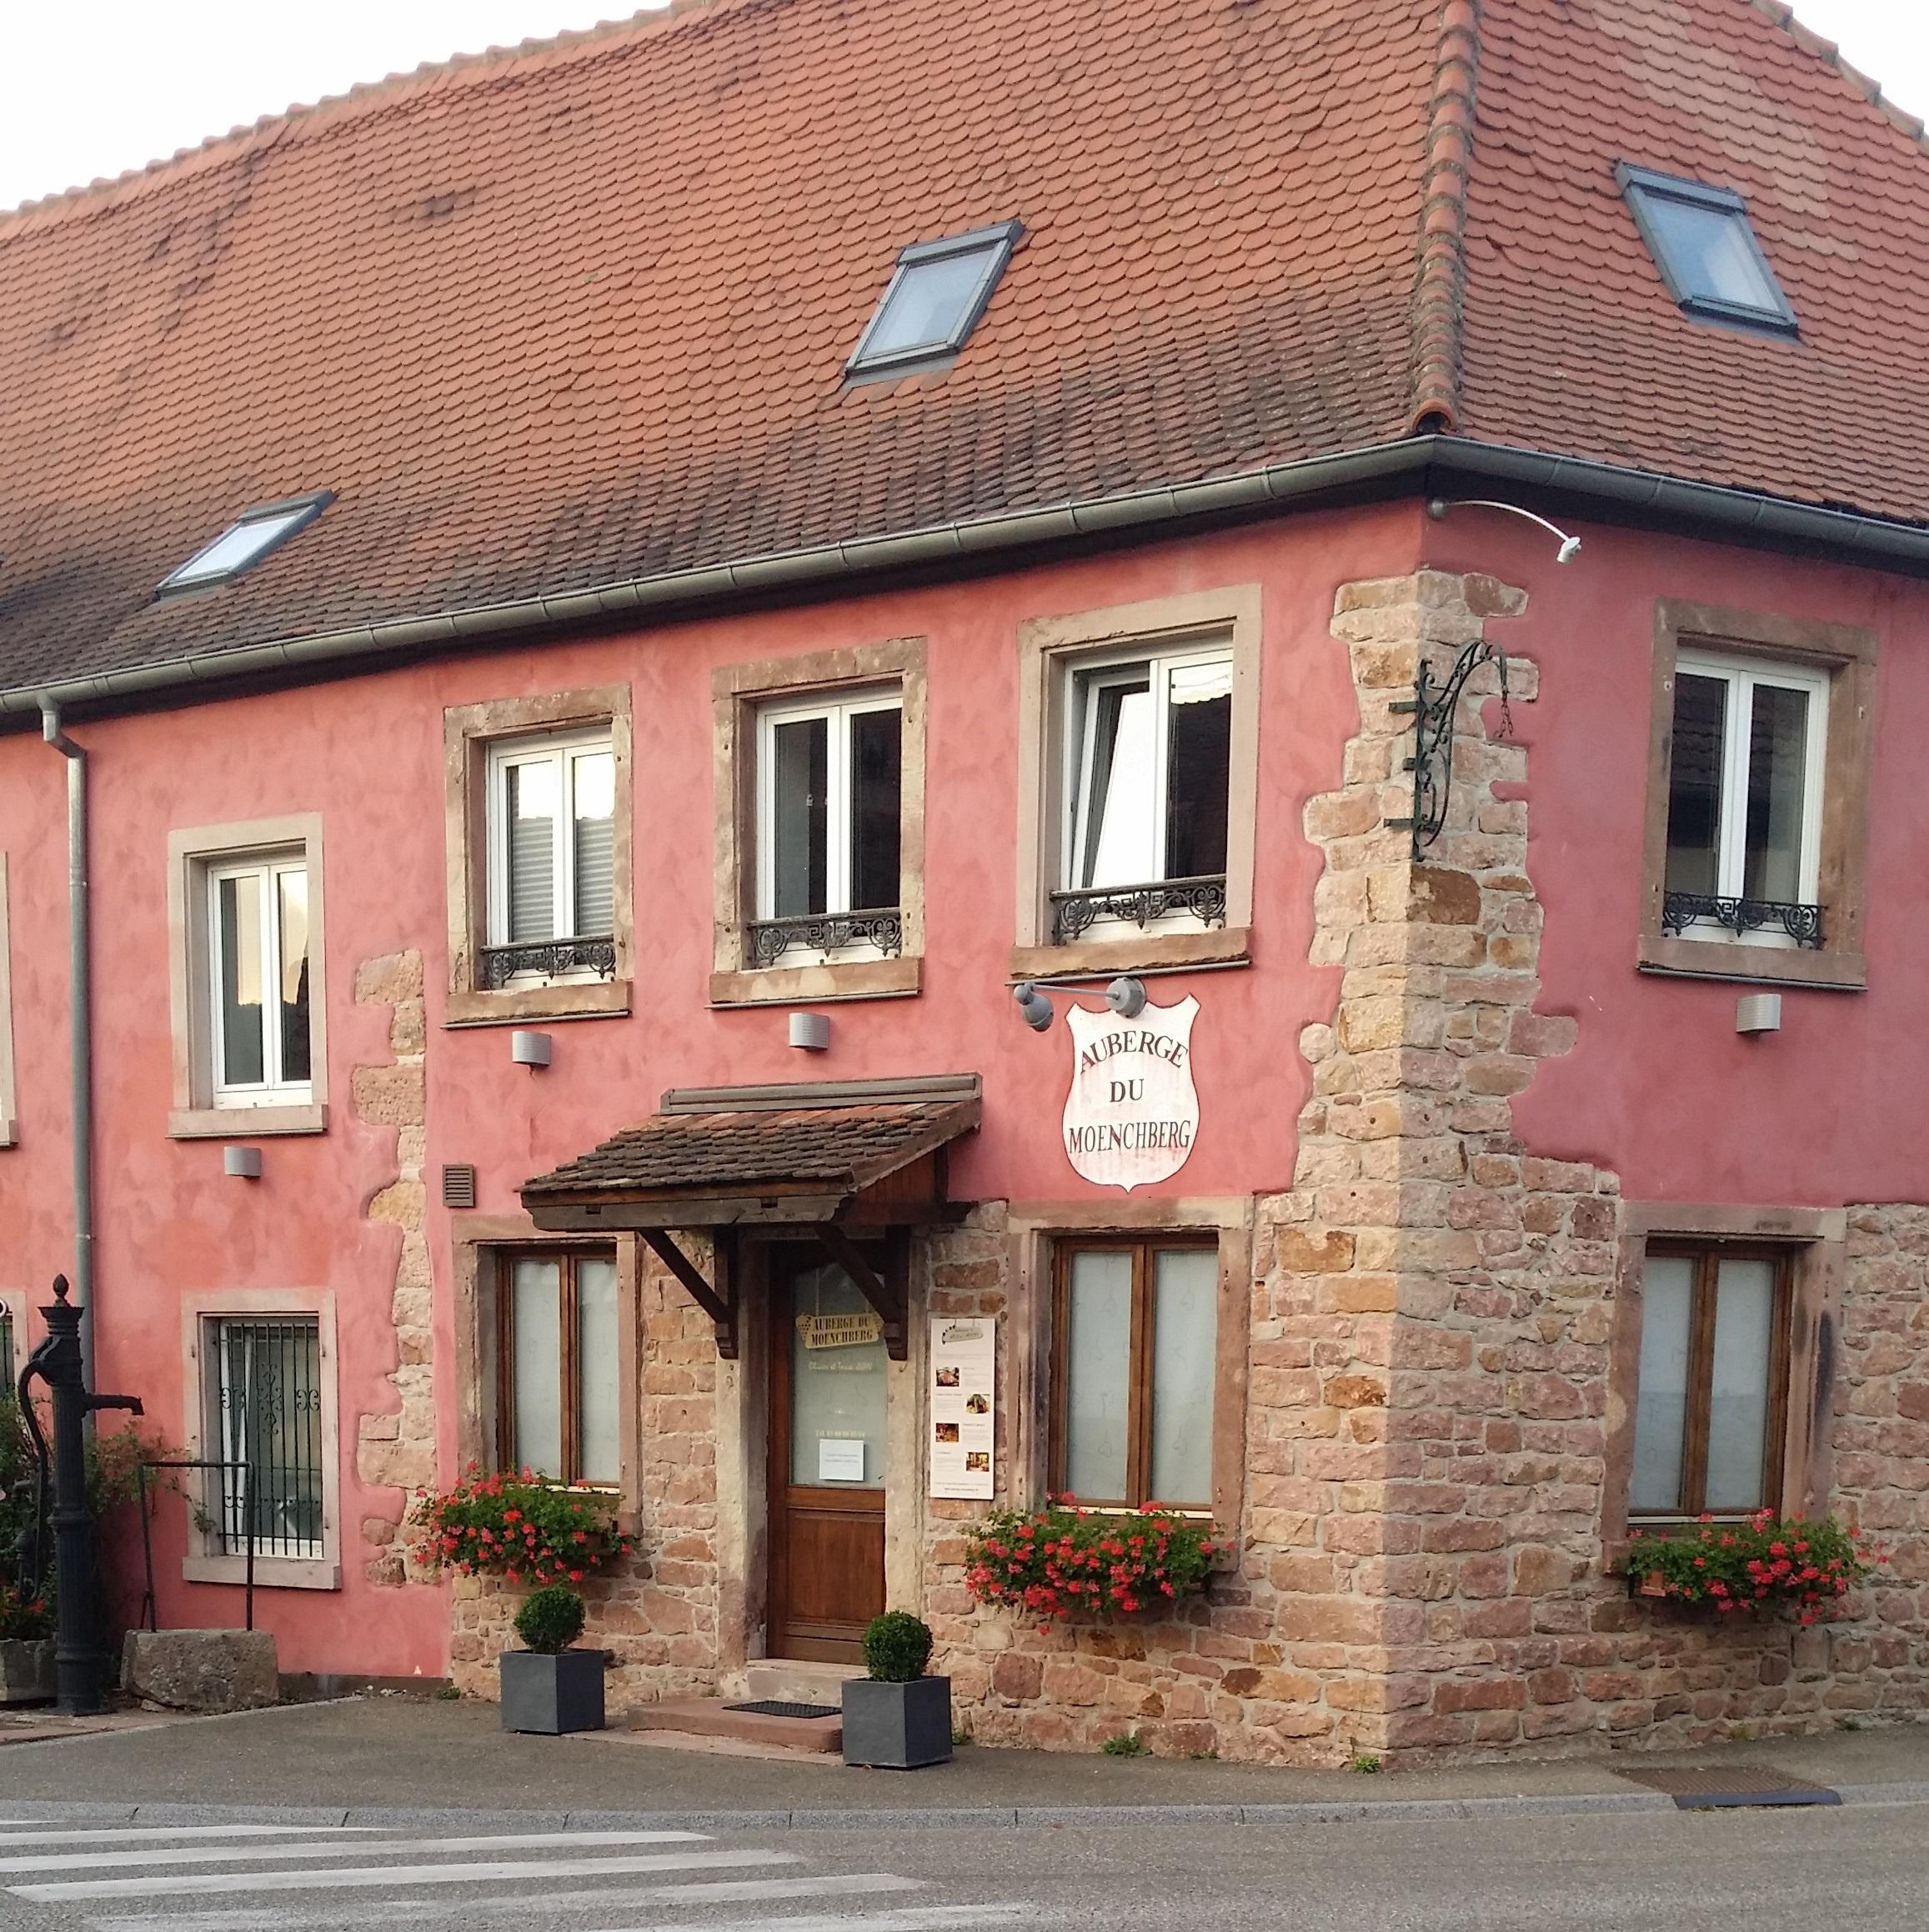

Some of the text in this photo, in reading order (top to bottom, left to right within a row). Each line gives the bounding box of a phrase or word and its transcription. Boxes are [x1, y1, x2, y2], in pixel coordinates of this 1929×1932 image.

[1080, 1030, 1189, 1074] AUBERGE
[1110, 1079, 1145, 1103] DU
[1069, 1120, 1191, 1154] MOENCHBERG
[814, 1316, 869, 1331] AUBERGE DU
[811, 1329, 873, 1346] MOENCHBERG
